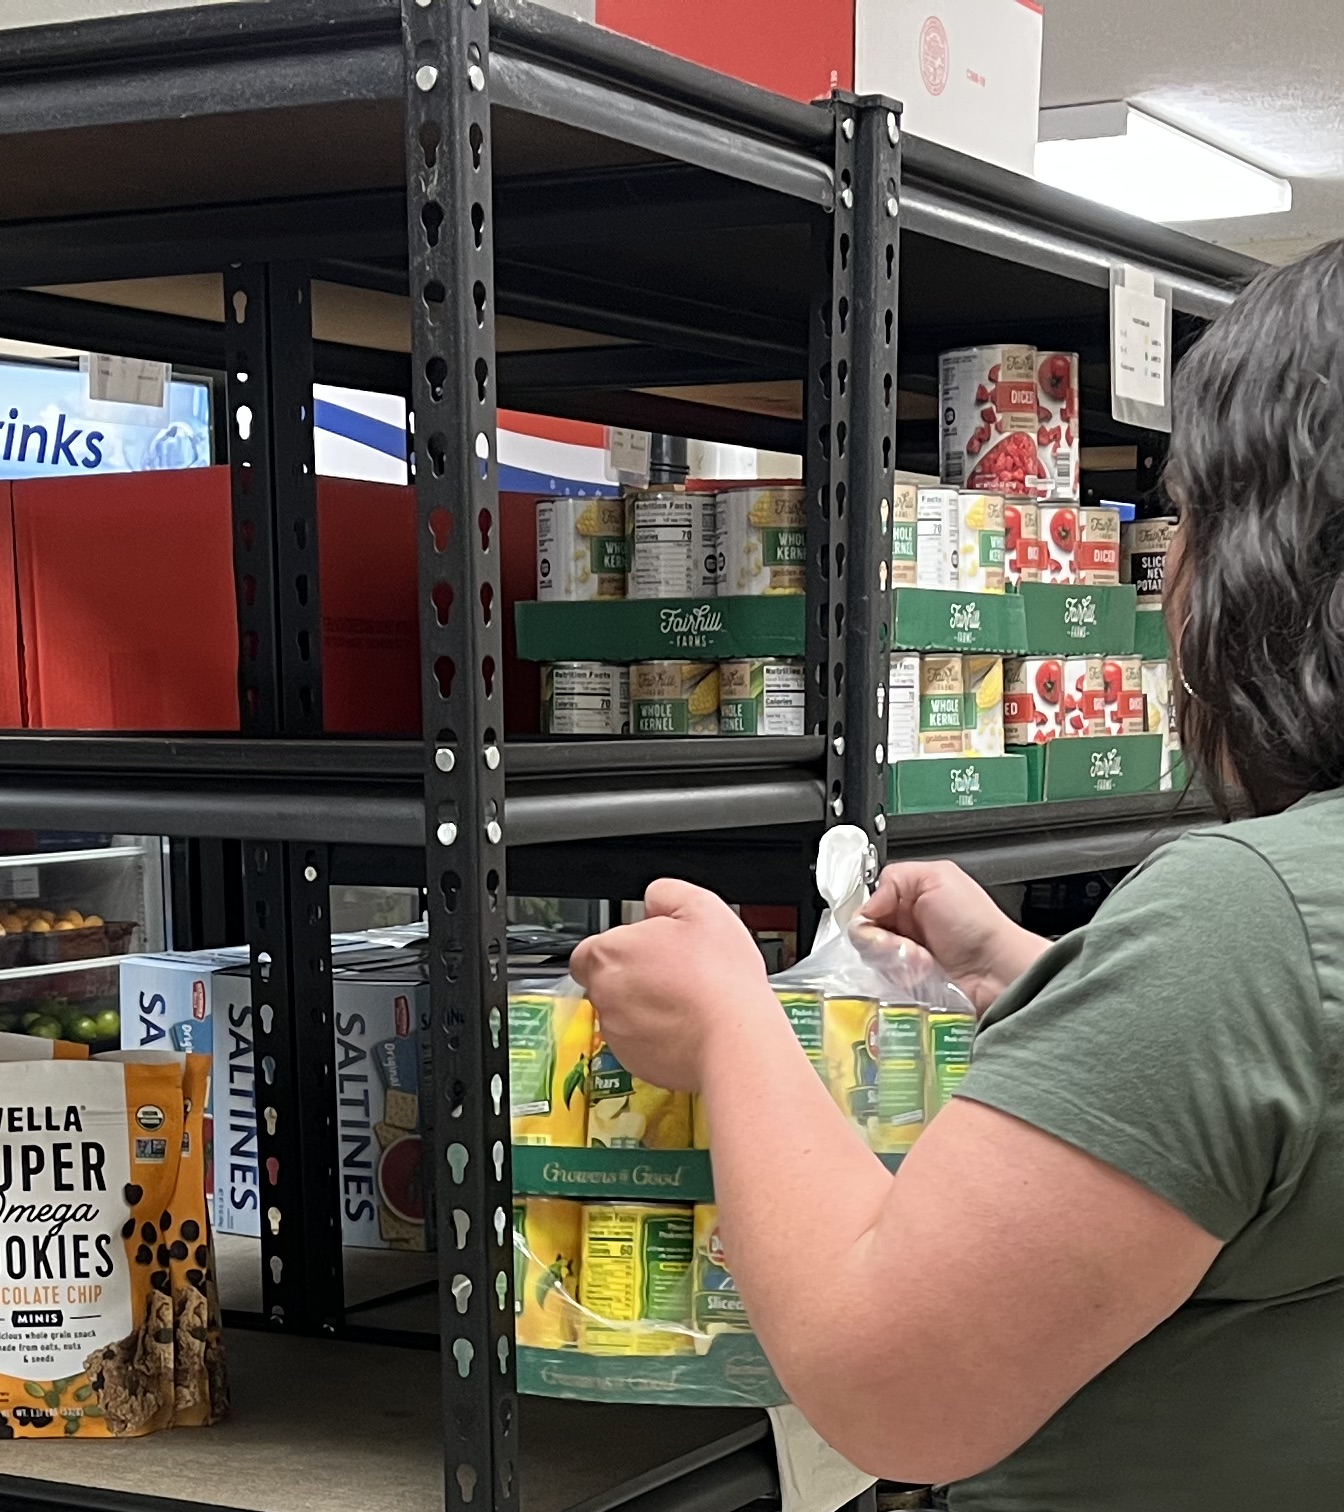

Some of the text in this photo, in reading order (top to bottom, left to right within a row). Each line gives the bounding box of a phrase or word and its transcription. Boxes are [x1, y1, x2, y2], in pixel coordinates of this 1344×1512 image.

[659, 604, 723, 635] Fairhill
[676, 635, 706, 647] FARMS
[640, 704, 672, 716] WHOLE
[931, 699, 959, 713] WHOLE
[639, 717, 674, 731] KERNEL
[929, 711, 961, 727] KERNEL
[384, 1043, 402, 1088] Original
[595, 1076, 620, 1089] Pears
[228, 1003, 258, 1212] SALTINES
[336, 1011, 375, 1224] SALTINES
[543, 1161, 617, 1184] Growers
[632, 1165, 684, 1187] Good
[620, 1244, 633, 1256] 60
[67, 1285, 103, 1304] CHIP
[17, 1313, 59, 1324] MINIS
[25, 1332, 48, 1340] whole
[50, 1331, 72, 1342] grain
[73, 1330, 97, 1339] snack
[18, 1343, 38, 1351] from
[40, 1343, 61, 1352] oats,
[63, 1342, 82, 1350] nuts
[23, 1354, 55, 1363] & seeds
